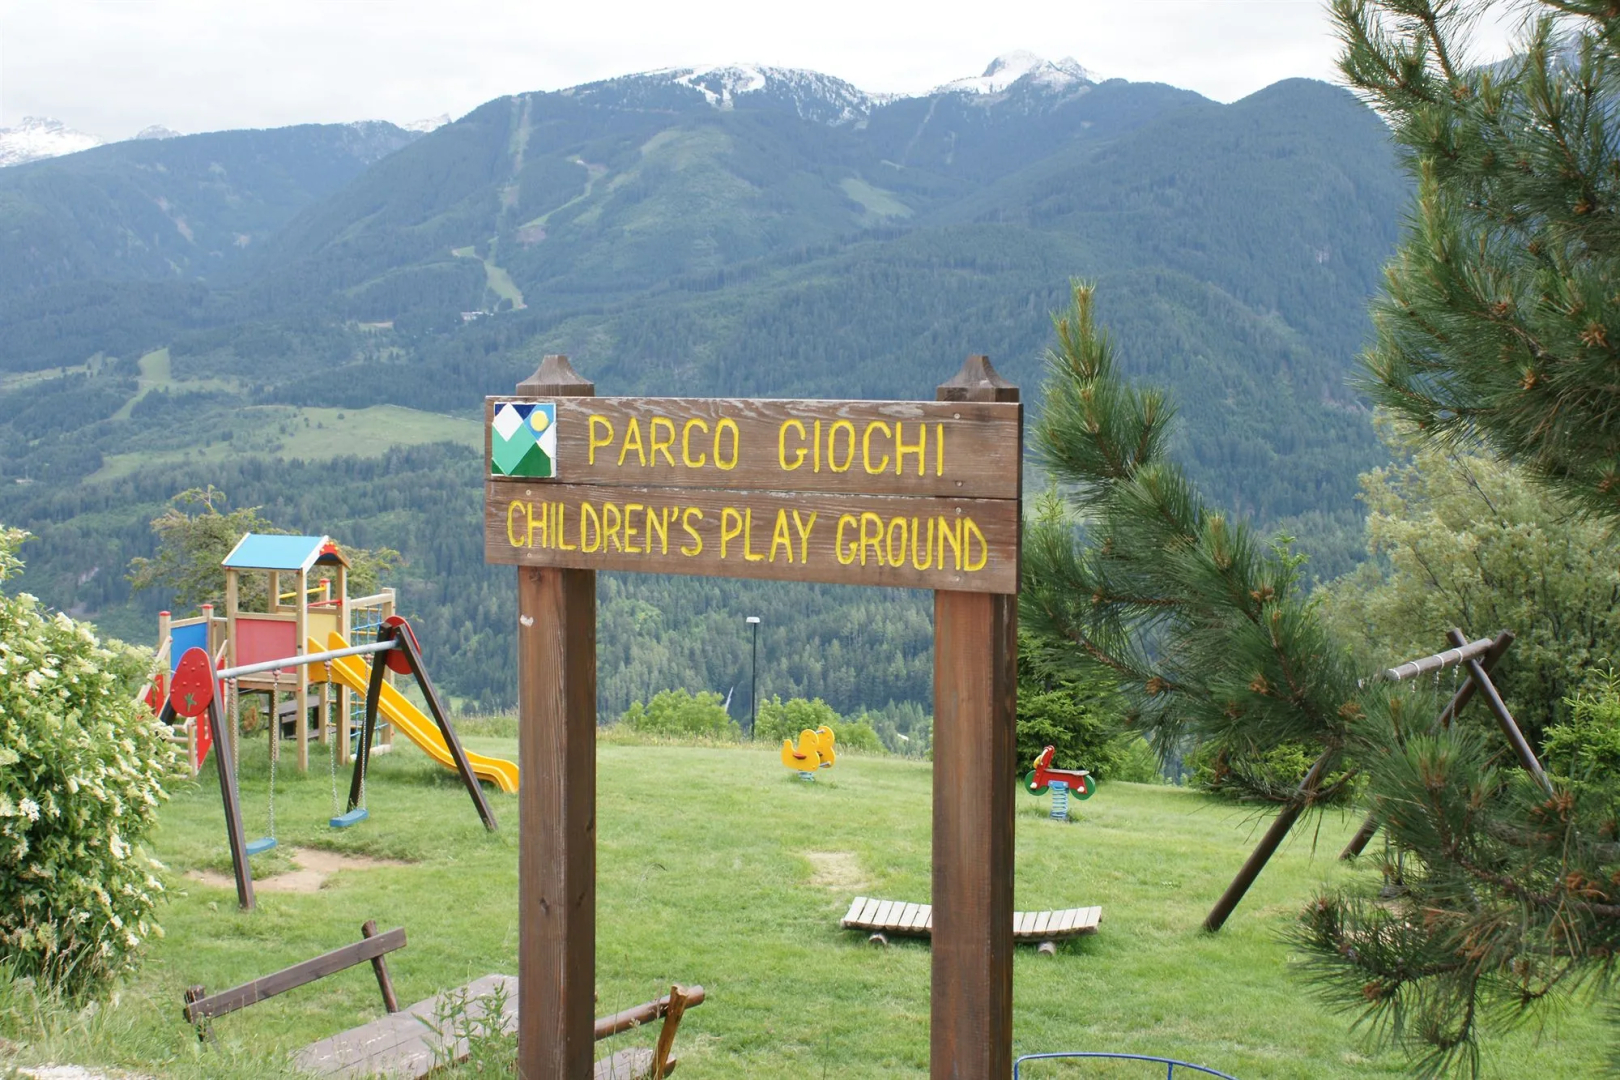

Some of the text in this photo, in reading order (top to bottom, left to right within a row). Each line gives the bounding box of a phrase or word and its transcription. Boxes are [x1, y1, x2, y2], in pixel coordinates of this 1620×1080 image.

[587, 414, 946, 478] PARCO GIOCHI
[506, 499, 989, 573] CHILDREN'S PLAY GROUND
